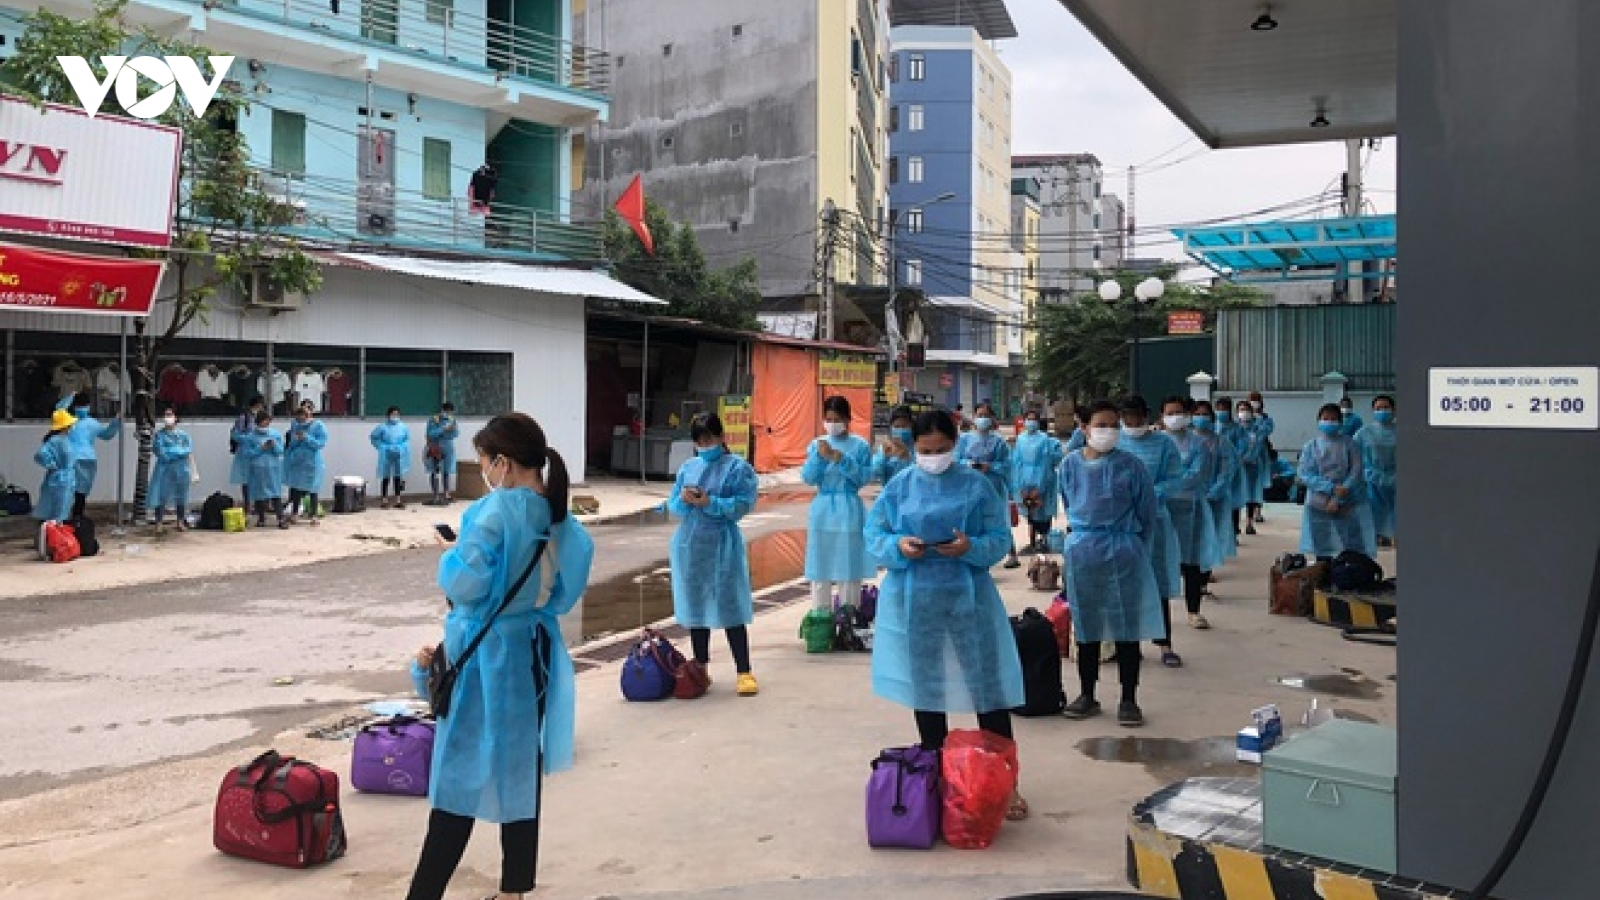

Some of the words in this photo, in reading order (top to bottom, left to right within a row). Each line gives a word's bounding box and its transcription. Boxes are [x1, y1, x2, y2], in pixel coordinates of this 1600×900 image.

[1548, 377, 1579, 387] OPEN
[1441, 396, 1491, 412] 05:00
[1529, 397, 1584, 413] 21:00
